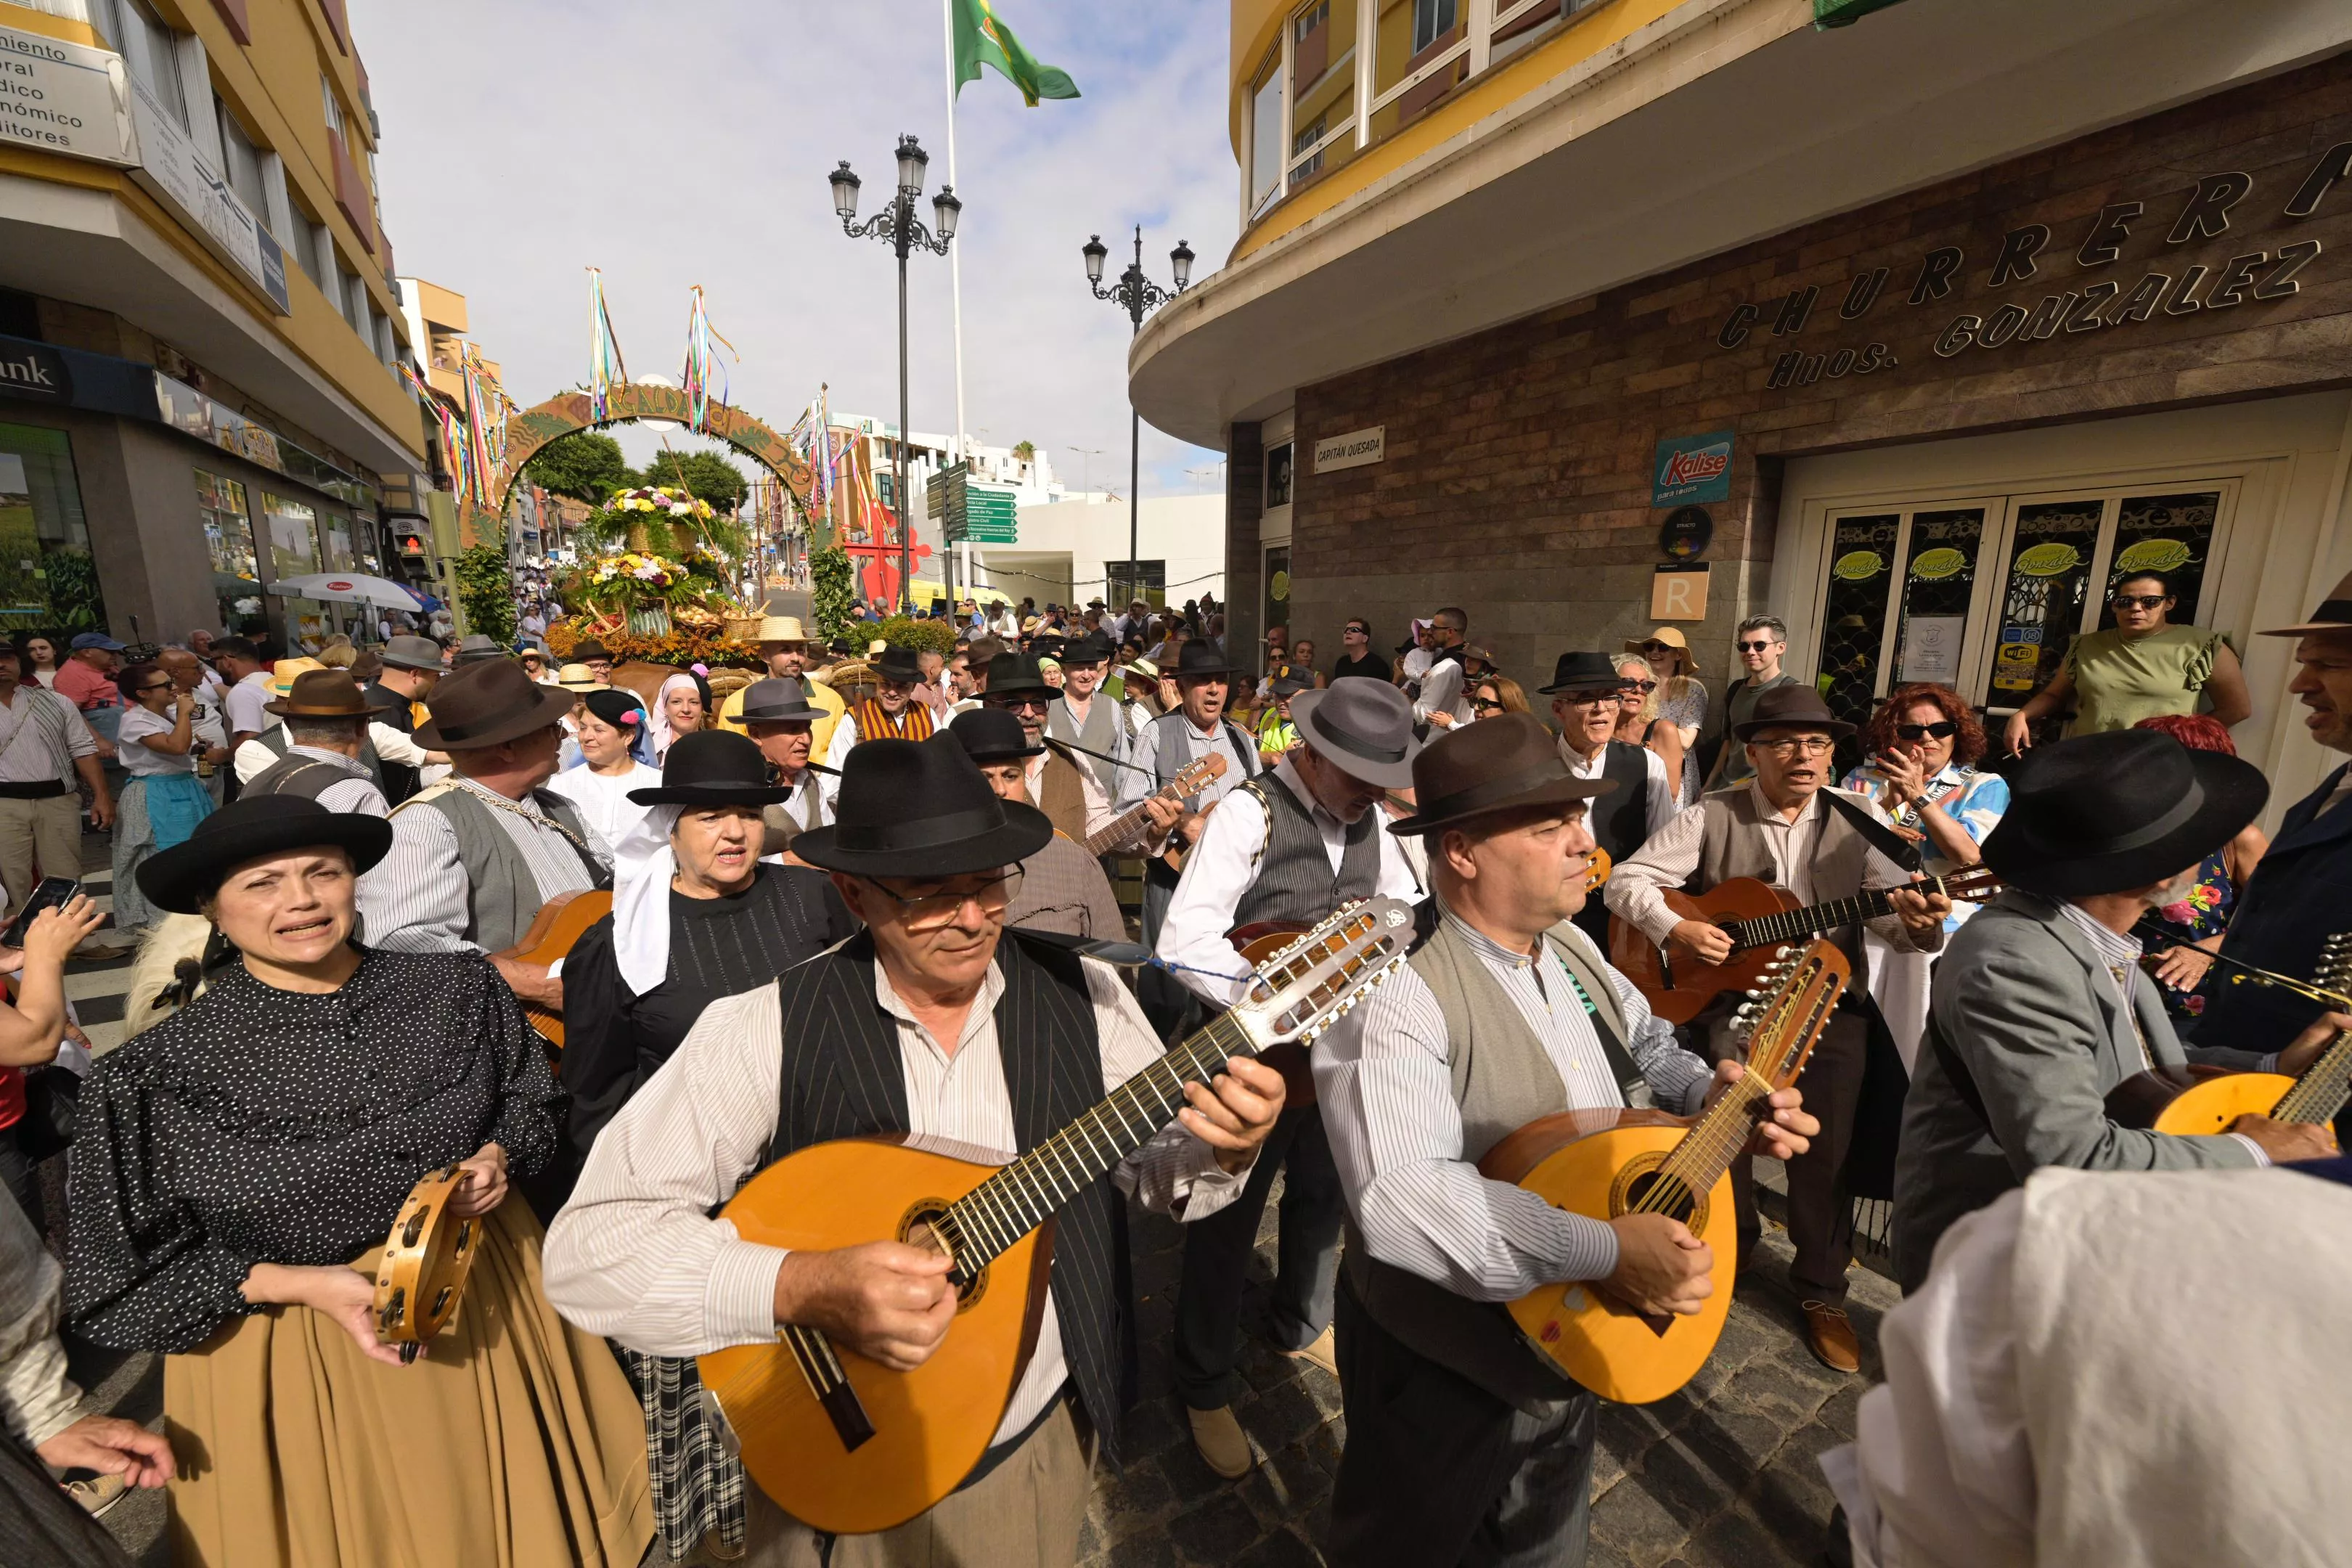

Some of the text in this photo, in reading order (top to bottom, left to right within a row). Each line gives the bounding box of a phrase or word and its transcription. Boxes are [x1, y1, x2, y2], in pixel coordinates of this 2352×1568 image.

[0, 60, 34, 77] ral
[0, 120, 70, 146] itores
[1933, 240, 2322, 358] GONZALEZ
[1318, 438, 1380, 462] CAPITÁN QUESADA
[1665, 450, 1728, 487] Kalise
[1657, 485, 1697, 501] para todos
[2014, 545, 2090, 577] González
[2115, 541, 2203, 576] González
[1665, 578, 1692, 614] R
